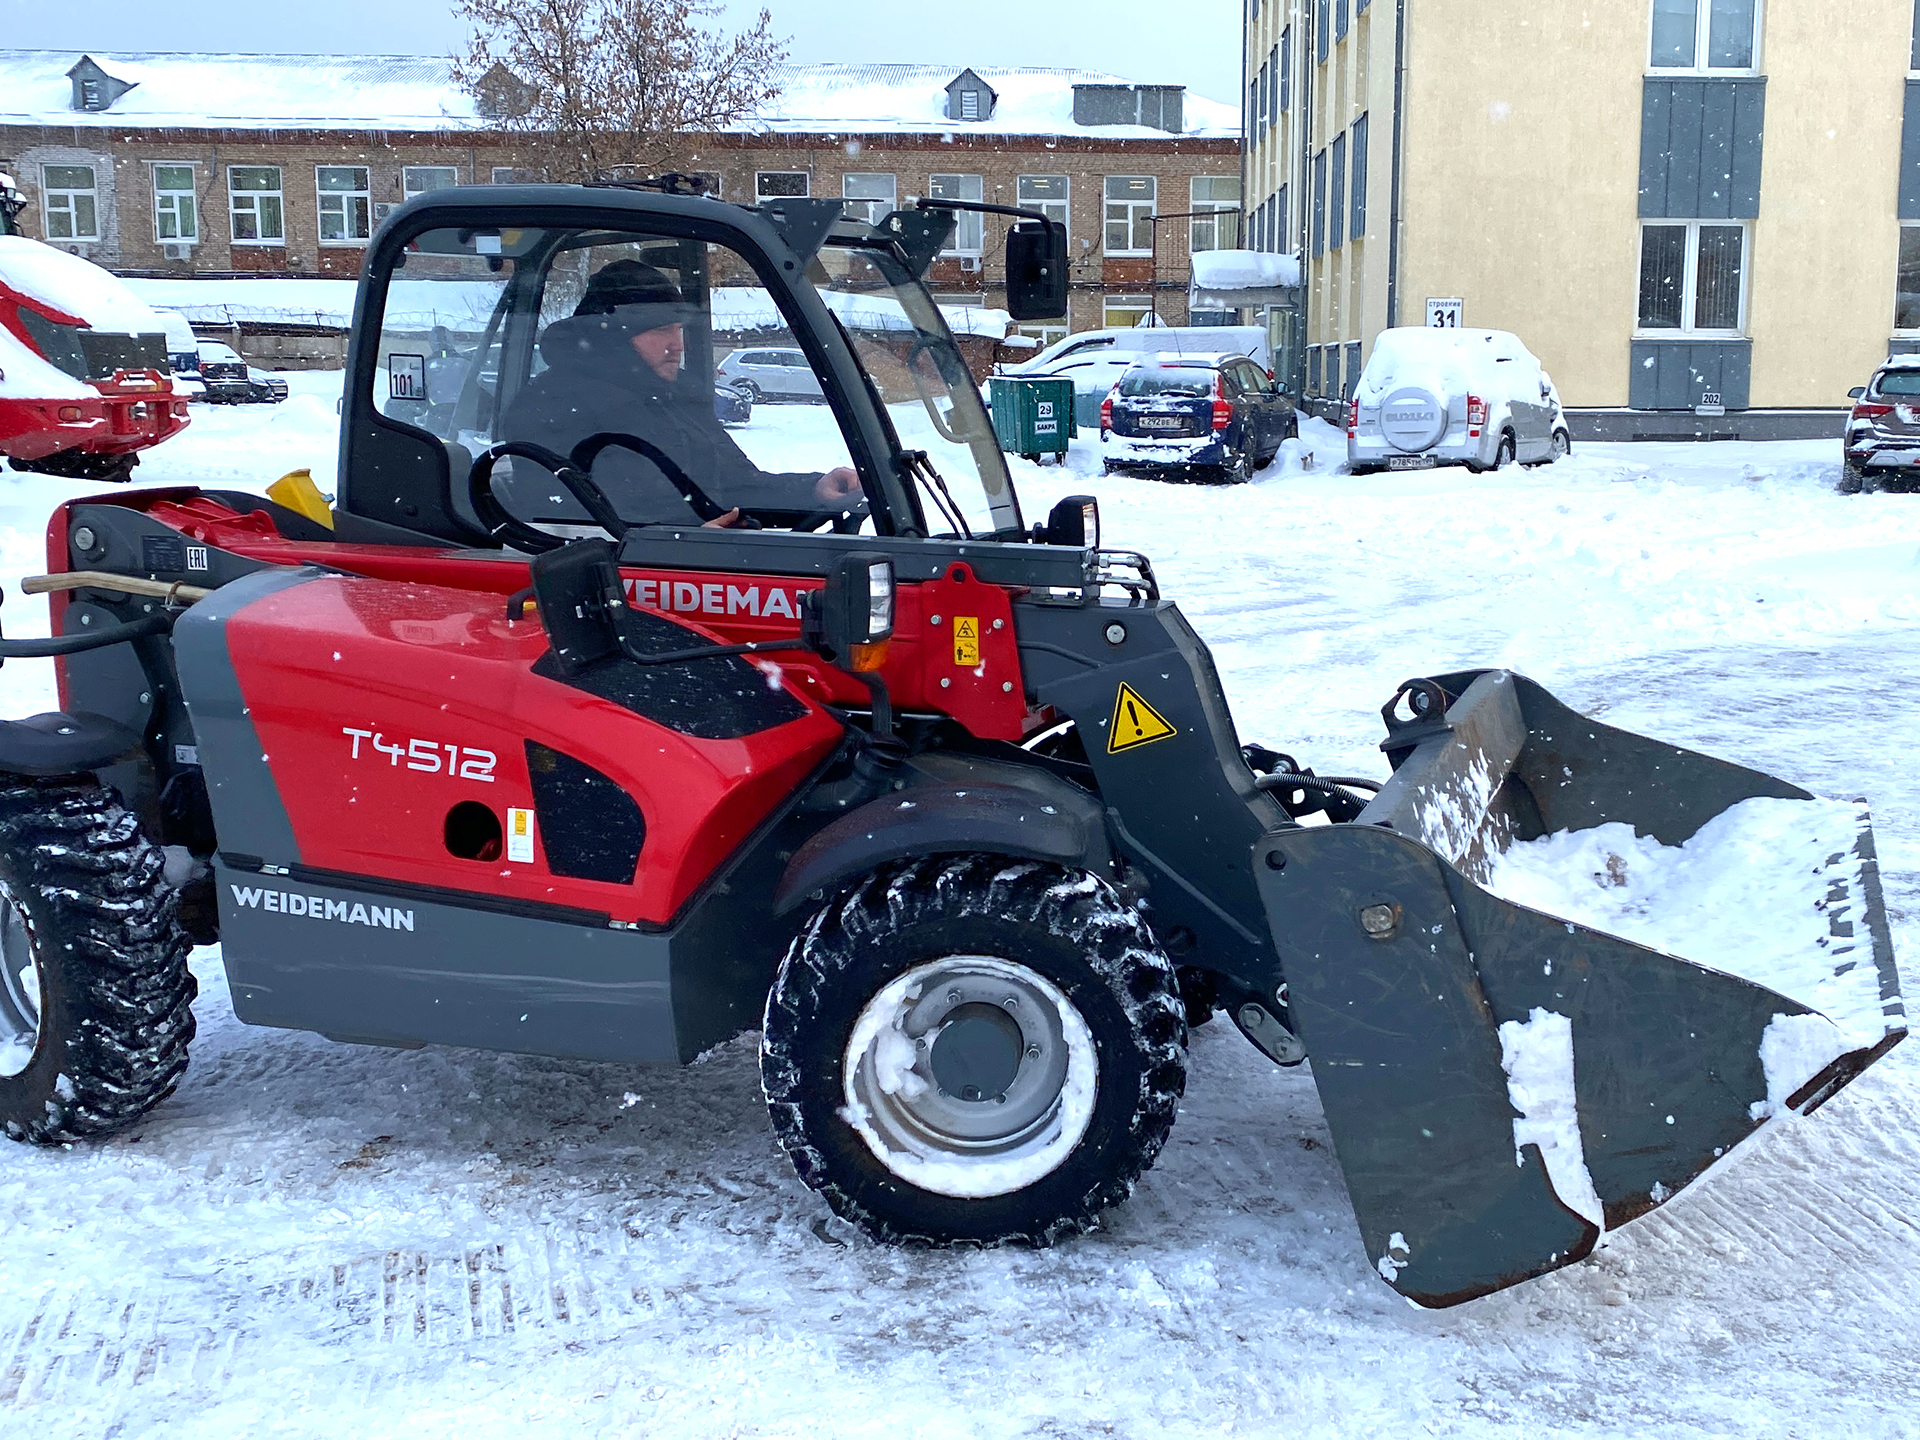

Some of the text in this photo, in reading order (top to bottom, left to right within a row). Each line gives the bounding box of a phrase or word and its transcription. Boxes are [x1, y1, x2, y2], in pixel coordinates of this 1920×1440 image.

[1433, 310, 1455, 328] 31
[393, 374, 413, 396] 101
[1703, 394, 1719, 403] 202
[1040, 405, 1052, 415] 29
[342, 727, 497, 782] T4512
[230, 884, 415, 932] WEIDEMANN
